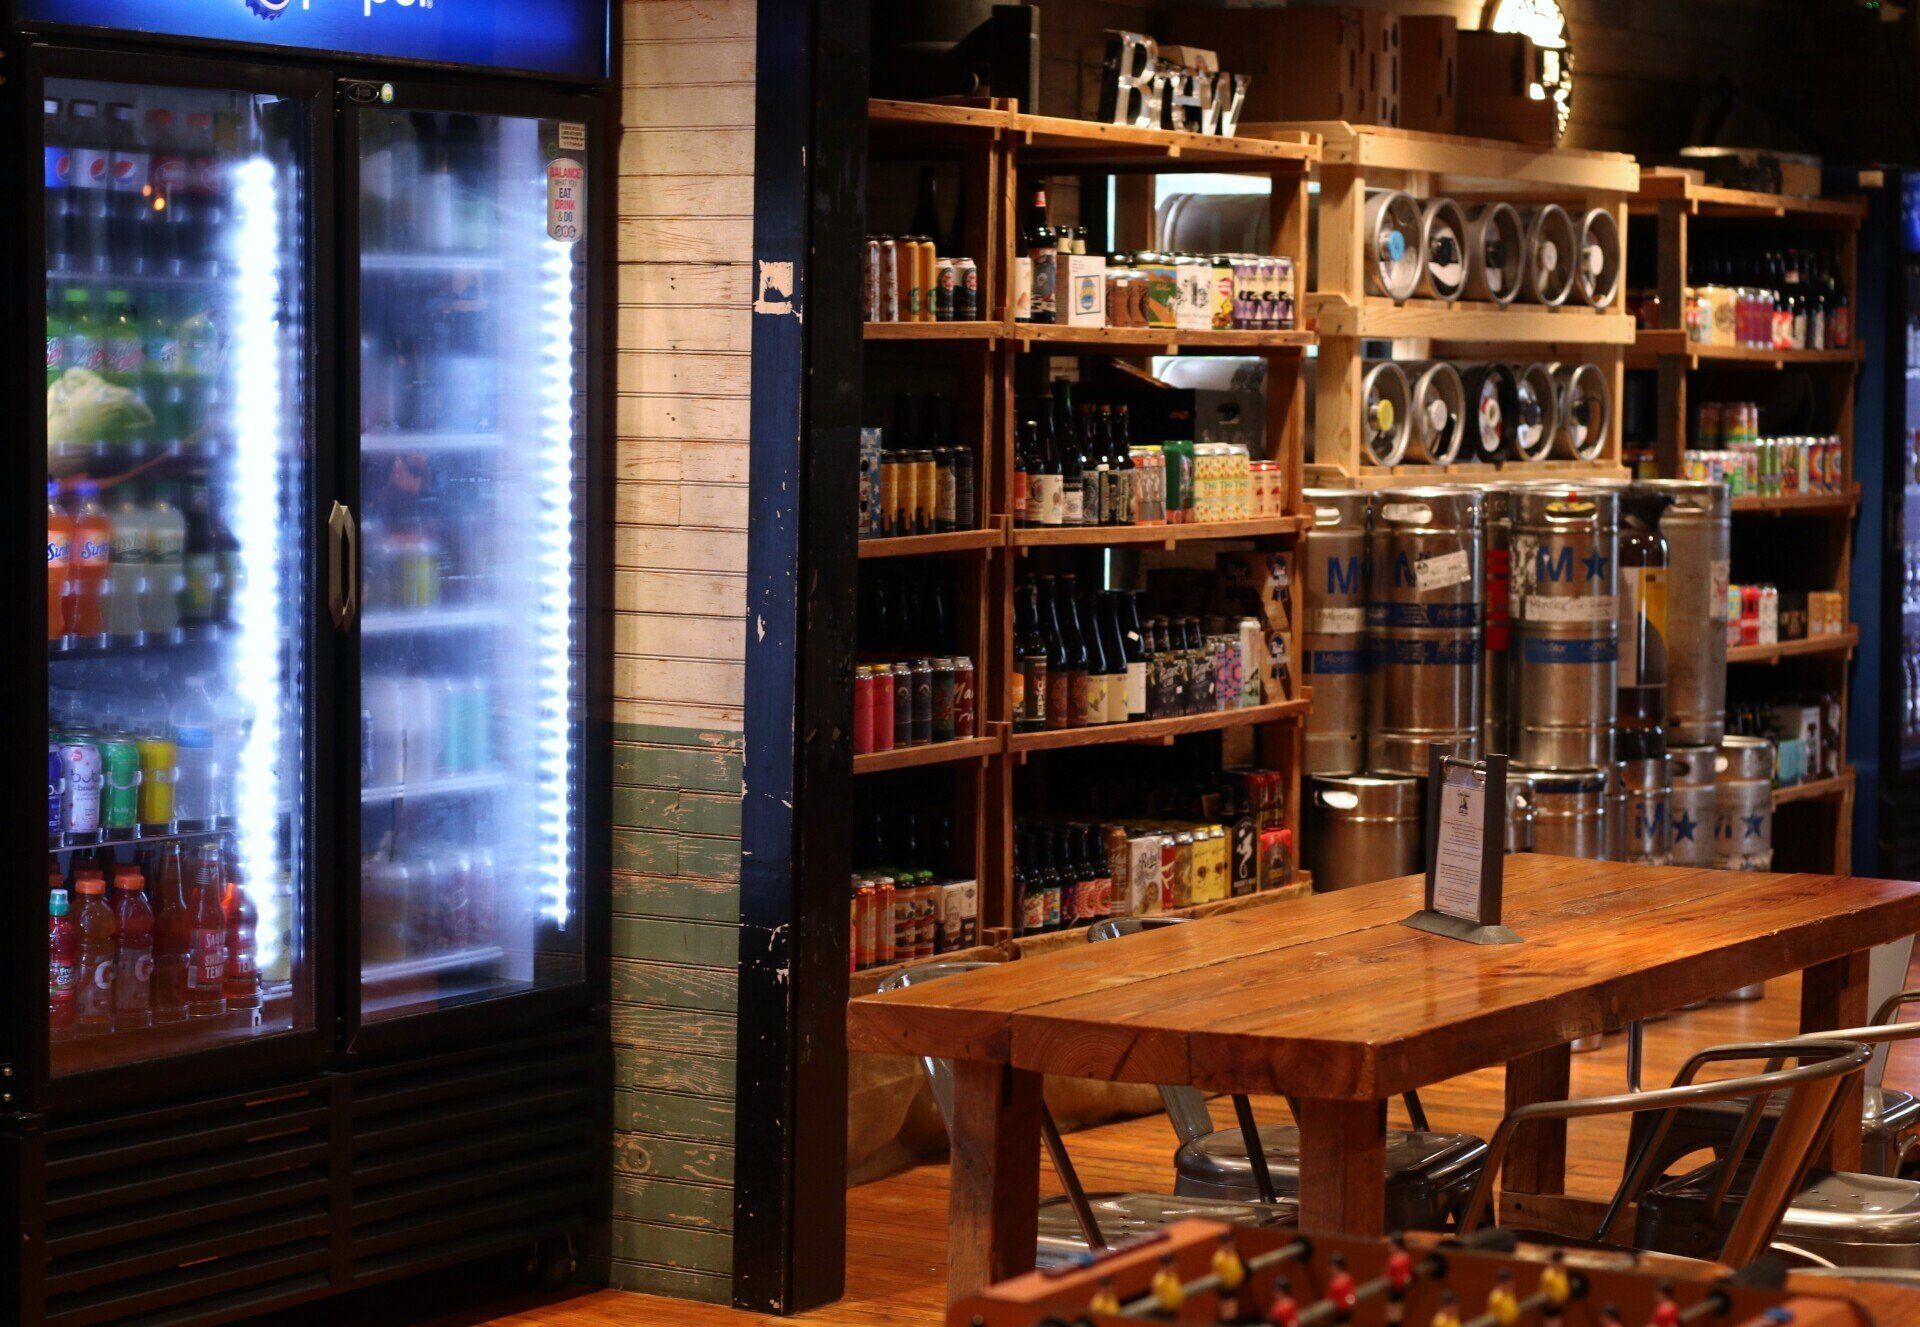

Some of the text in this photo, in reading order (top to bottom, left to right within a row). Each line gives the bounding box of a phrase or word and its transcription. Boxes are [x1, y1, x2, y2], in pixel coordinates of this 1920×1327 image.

[549, 166, 581, 179] BALANCE
[558, 187, 572, 198] EAT
[554, 199, 576, 210] DRINK
[563, 211, 573, 222] DO
[1537, 546, 1574, 583] M
[1327, 556, 1358, 595] M
